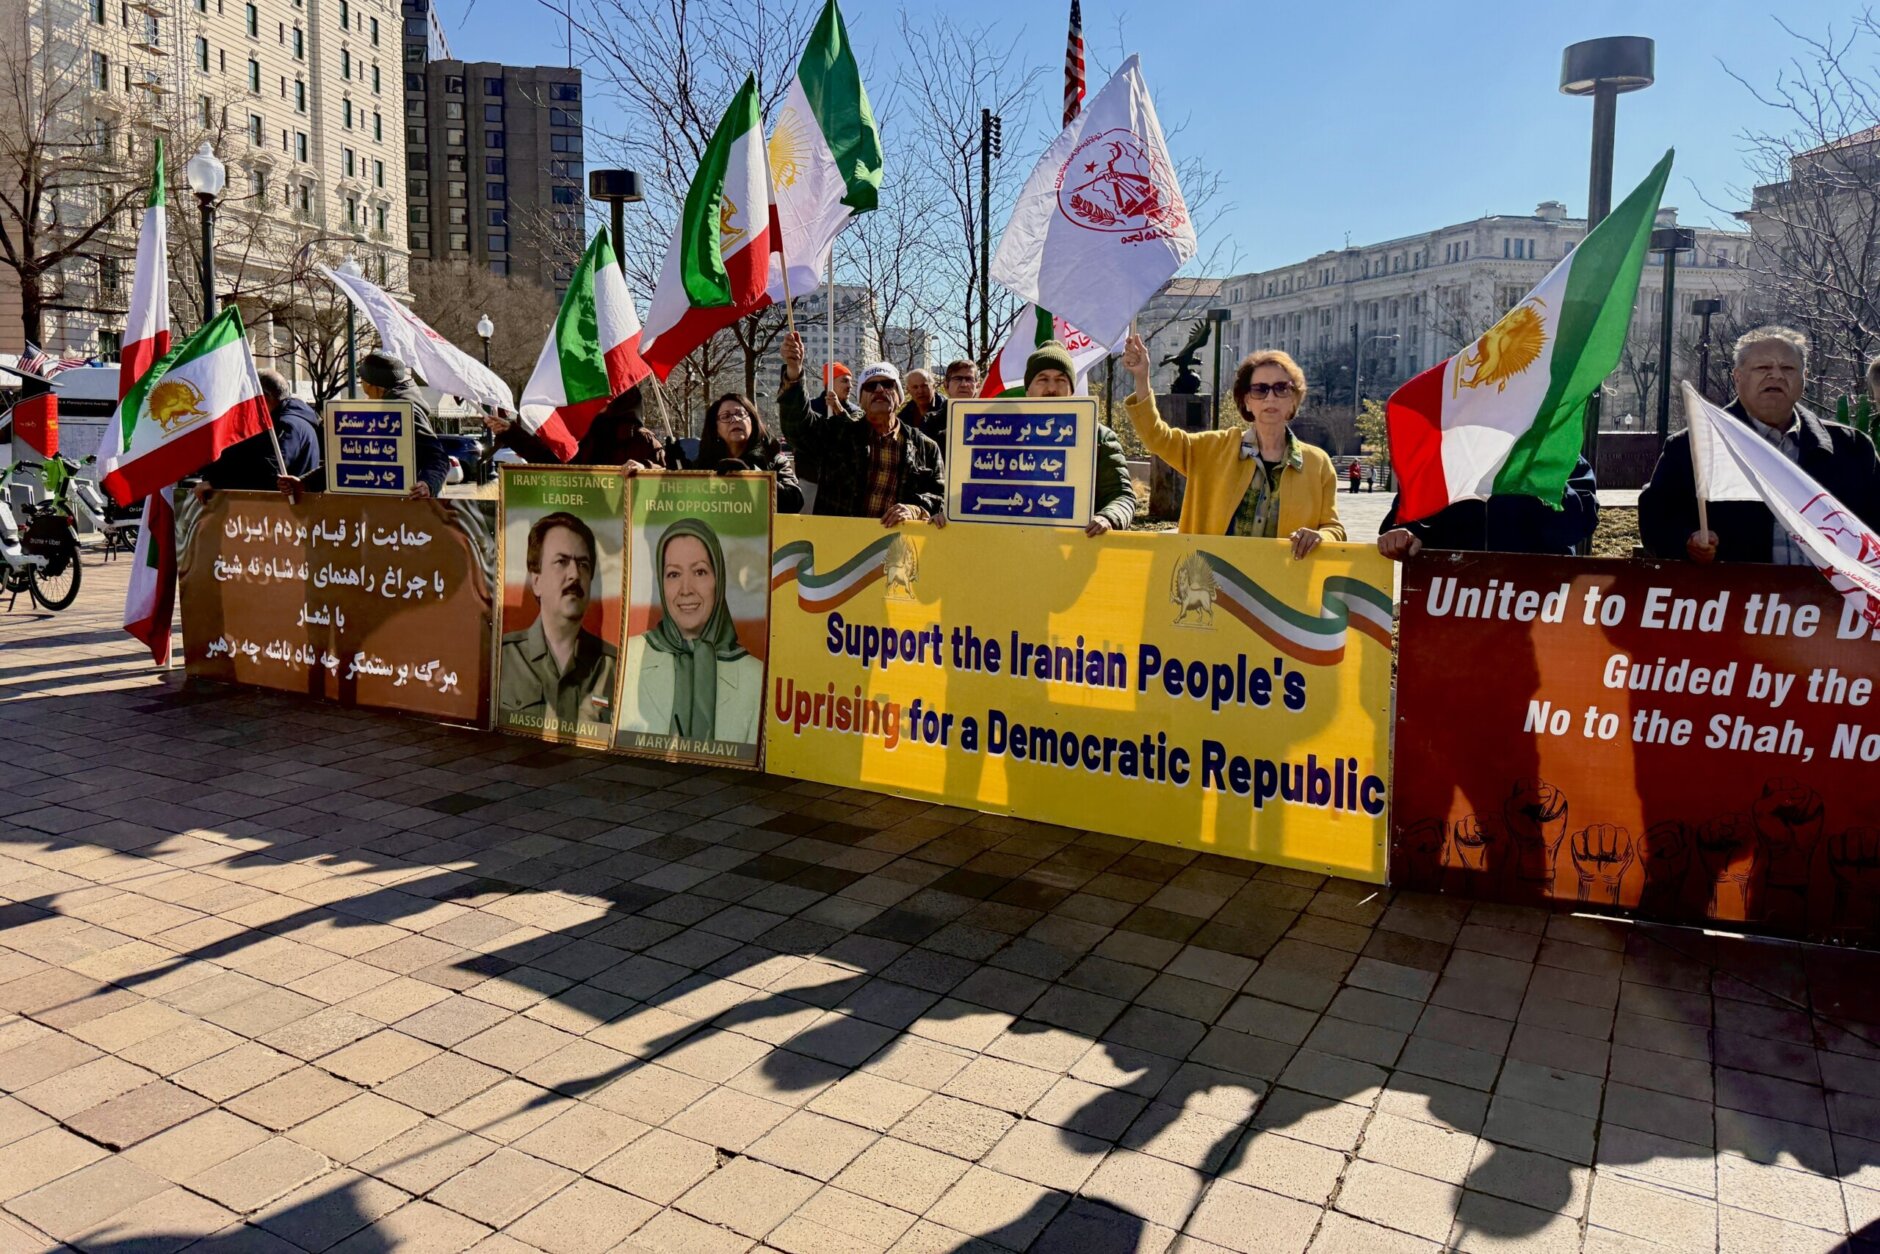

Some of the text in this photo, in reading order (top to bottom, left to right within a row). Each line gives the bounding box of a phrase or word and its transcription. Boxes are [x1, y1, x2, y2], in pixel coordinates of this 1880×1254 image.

[336, 414, 400, 433] مرگ بر ستمگر
[966, 417, 1073, 442] مرگ بر ستمگر
[342, 440, 396, 460] چه شاه باشه
[343, 470, 396, 486] چه رهبر
[973, 452, 1063, 479] چه شاه باشه
[513, 474, 615, 489] IRAN'S RESISTANCE
[661, 481, 736, 495] THE FACE OF
[542, 493, 583, 505] LEADER
[645, 499, 752, 514] IRAN OPPOSITION
[972, 491, 1060, 514] چه رهبر
[225, 515, 432, 551] حمایت از قیام مردم ایران
[213, 554, 445, 599] با چراغ راهنمای نه شاه نه شیخ
[296, 602, 345, 634] با شعار
[1426, 576, 1880, 640] United to End the D
[205, 636, 237, 659] رهبر
[241, 638, 261, 664] چه
[265, 640, 291, 666] باشه
[294, 644, 316, 666] شاه
[320, 649, 340, 677] چه
[827, 612, 1307, 713] Support the Iranian People's
[413, 660, 458, 693] مرگ
[1603, 654, 1872, 708] Guided by the
[509, 713, 598, 737] MASSOUD RAJAVI
[1523, 700, 1880, 763] No to the Shah, No
[635, 734, 738, 757] MARYAM RAJAVI
[775, 676, 1385, 817] Uprising for a Democratic Republic
